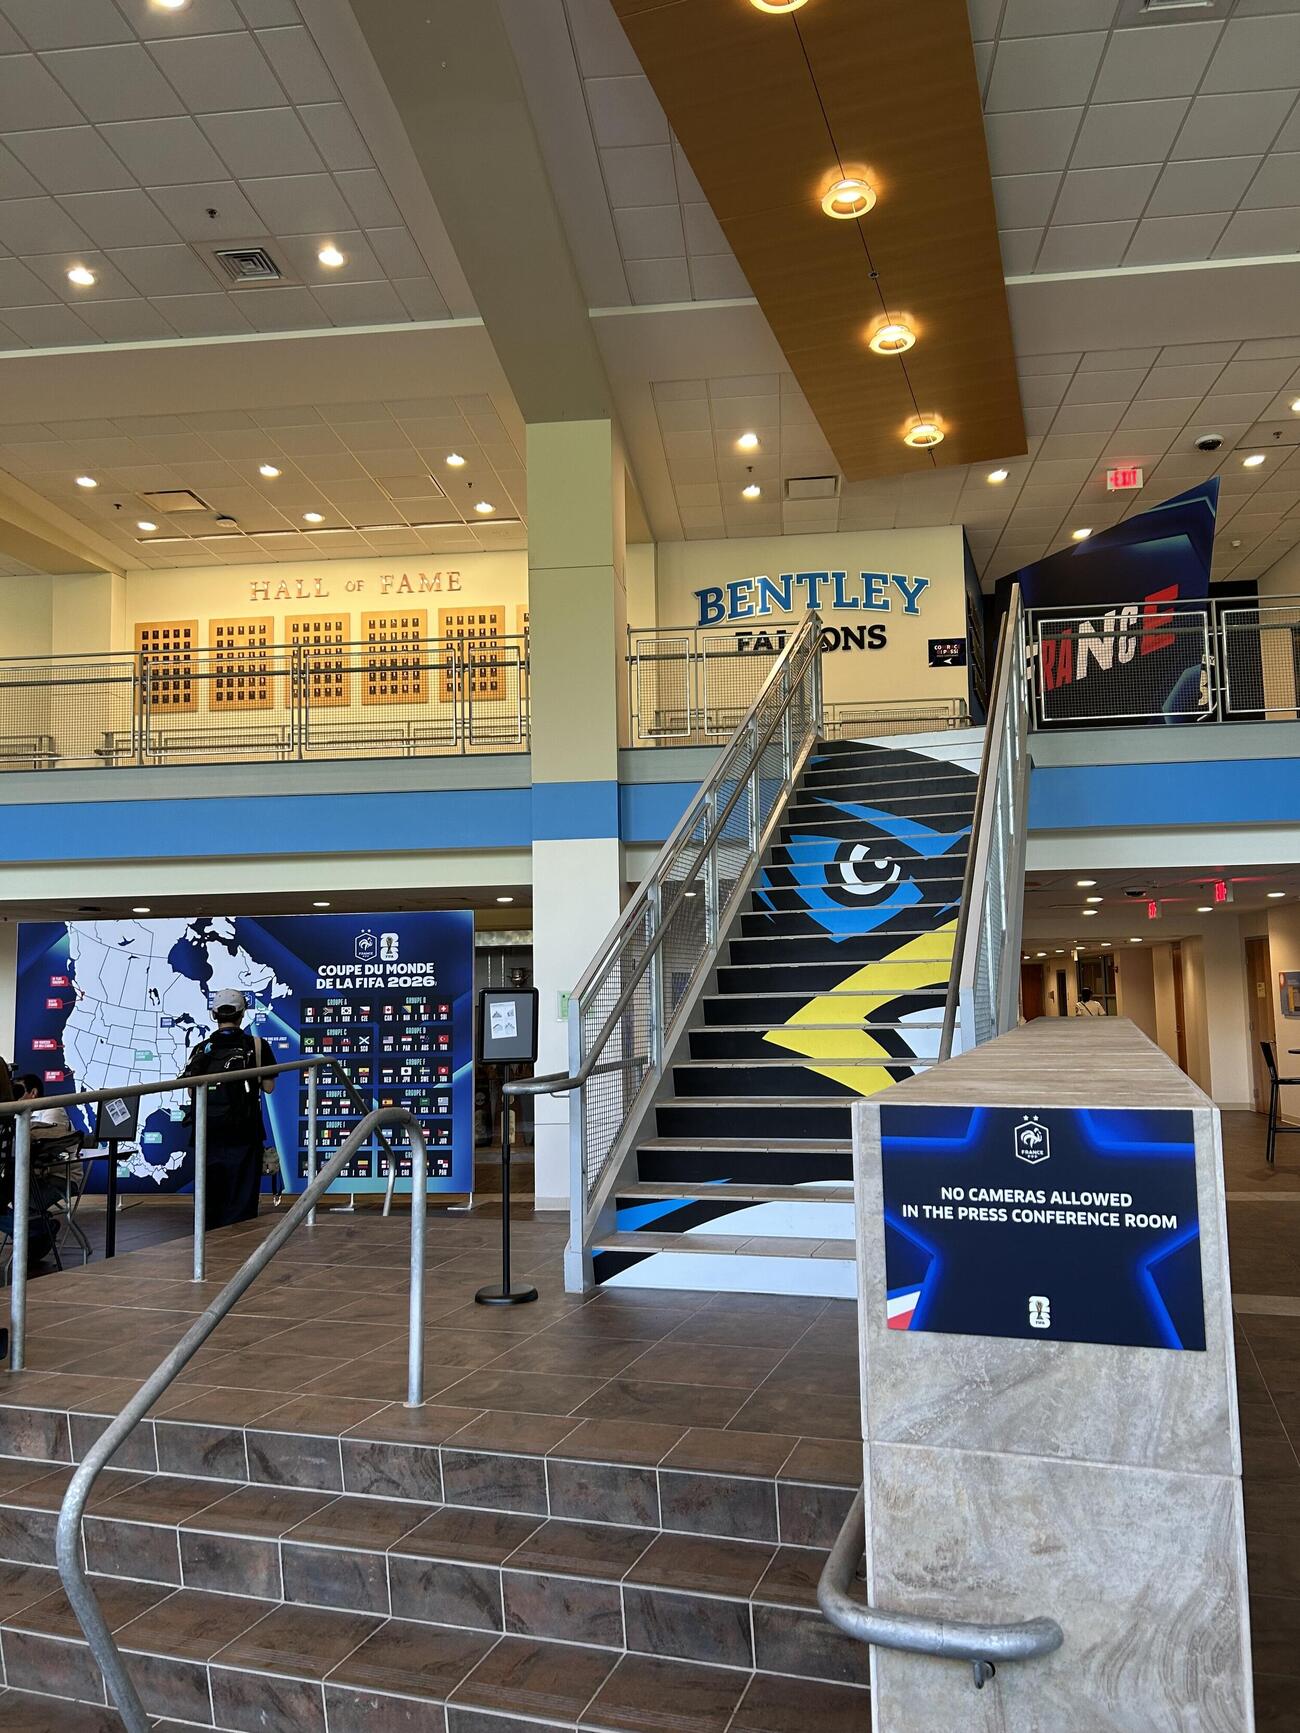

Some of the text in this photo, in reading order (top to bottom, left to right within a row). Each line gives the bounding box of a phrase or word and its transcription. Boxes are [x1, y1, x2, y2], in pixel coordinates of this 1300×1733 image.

[1114, 470, 1137, 487] EXIT
[250, 571, 462, 601] HALL OF FAME
[693, 571, 930, 626] BENTLEY
[736, 624, 887, 652] FALONS
[318, 962, 434, 976] COUPE DU MONDE
[316, 978, 334, 989] DE
[336, 978, 353, 989] LA
[356, 977, 385, 988] FIFA
[388, 976, 435, 987] 2026
[941, 1186, 1132, 1207] NO CAMERAS ALLOWED
[902, 1204, 1177, 1229] IN THE PRESS CONFERENCE ROOM
